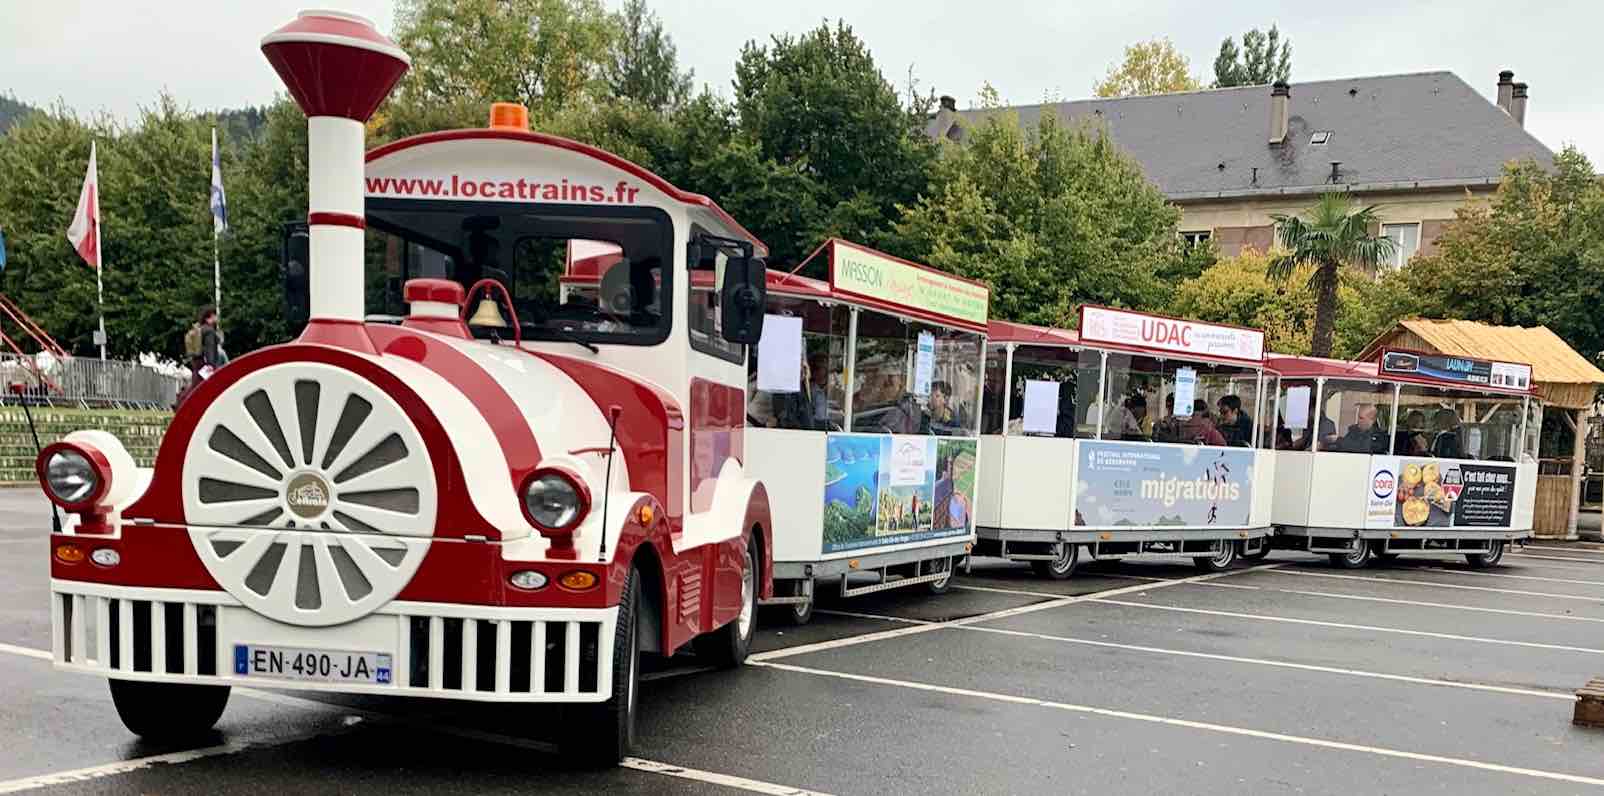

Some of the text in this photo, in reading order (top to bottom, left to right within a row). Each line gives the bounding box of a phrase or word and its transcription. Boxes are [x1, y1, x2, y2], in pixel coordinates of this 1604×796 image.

[365, 175, 640, 204] www.locatrains.fr
[841, 258, 883, 289] MASSON
[1142, 319, 1192, 347] UDAC
[1142, 472, 1240, 506] migrations
[1375, 479, 1393, 489] cora
[253, 649, 370, 679] EN-490-JA
[377, 671, 390, 681] 44
